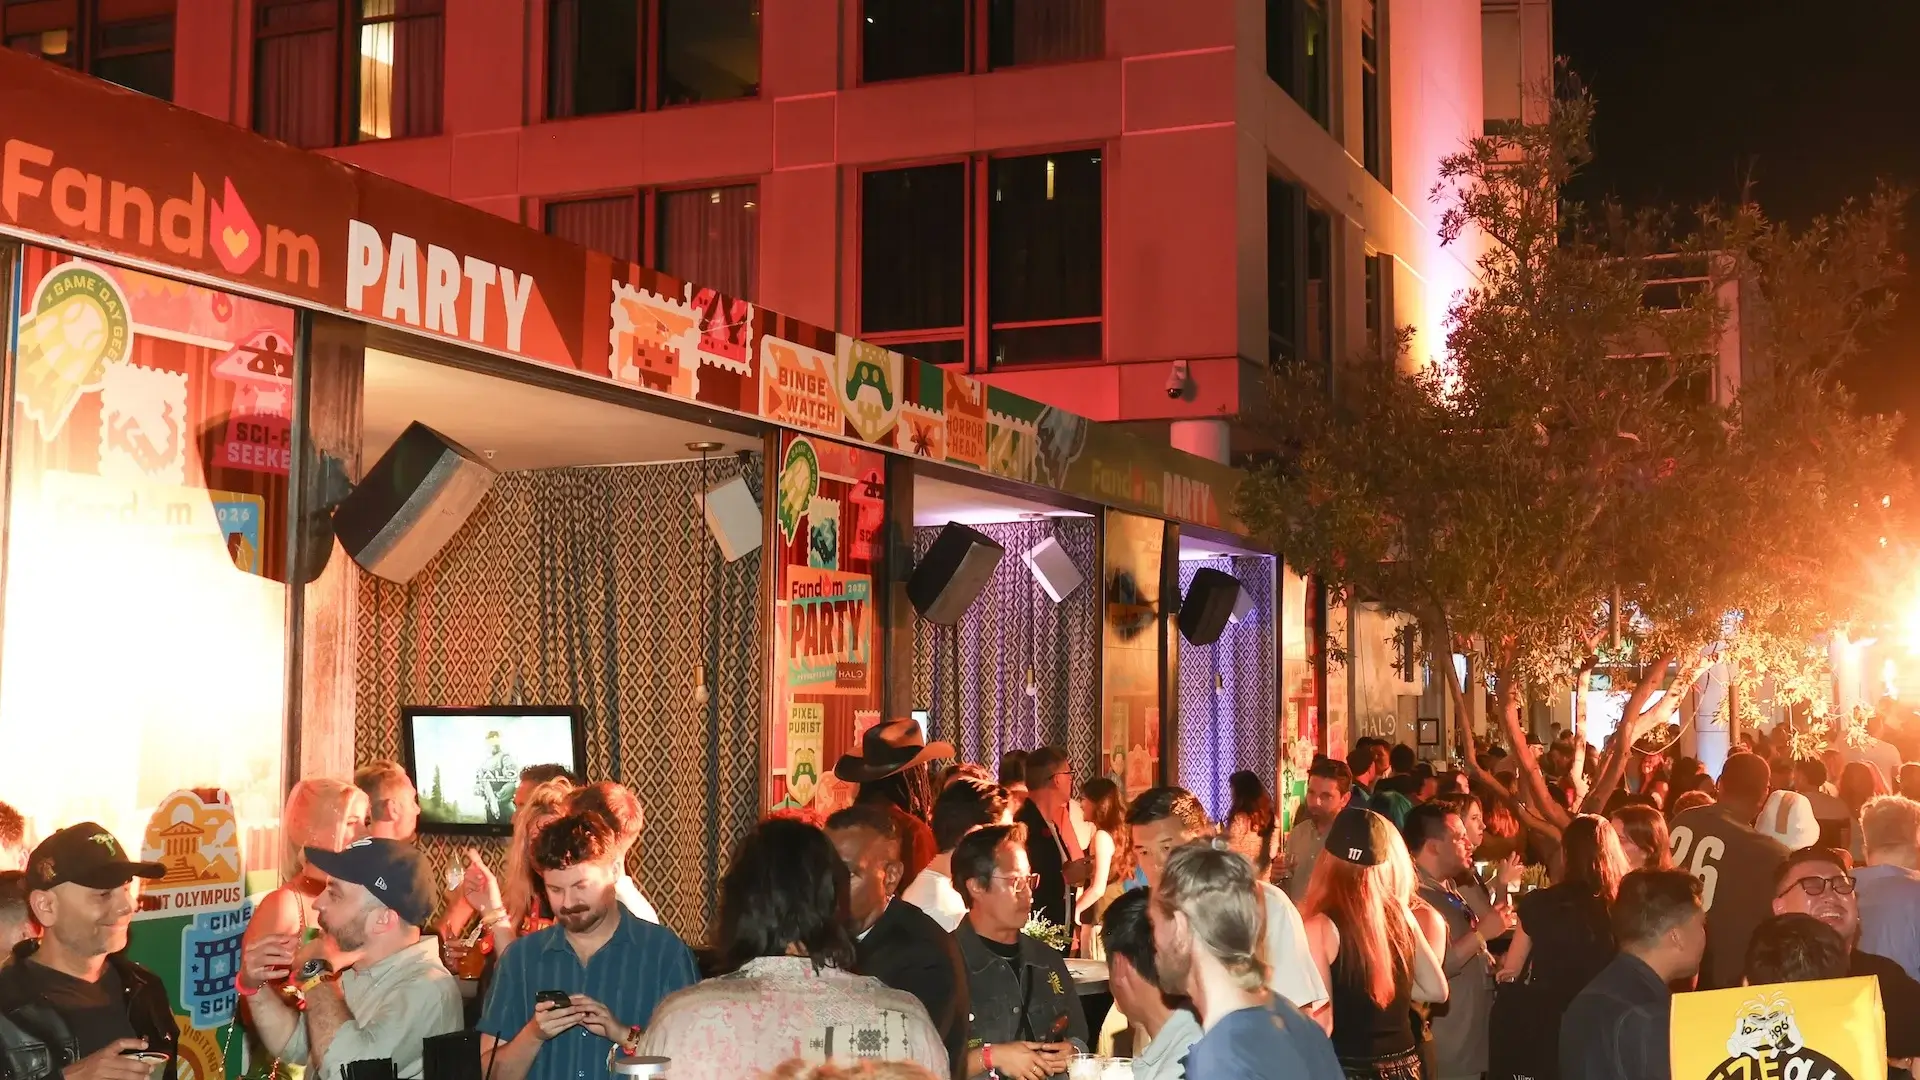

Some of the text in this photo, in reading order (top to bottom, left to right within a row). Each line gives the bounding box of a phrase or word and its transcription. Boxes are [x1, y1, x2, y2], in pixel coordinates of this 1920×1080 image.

[346, 218, 534, 352] PARTY
[54, 275, 123, 361] GAME DAY GEE
[778, 366, 826, 397] BINGE
[786, 393, 836, 423] WATCH
[236, 421, 290, 449] SCI-F
[946, 414, 983, 445] HORROR
[227, 441, 290, 469] SEEKE
[952, 435, 977, 458] HEAD
[1163, 470, 1210, 525] PARTY
[217, 507, 250, 523] 026
[790, 598, 863, 659] PARTY
[838, 670, 864, 678] HALO
[792, 707, 818, 720] PIXEL
[1360, 714, 1396, 737] HALO
[788, 721, 821, 734] PURIST
[1347, 847, 1363, 860] 117
[174, 886, 241, 909] OLYMPUS
[210, 910, 251, 931] CINE
[200, 993, 237, 1015] SCH
[183, 1023, 219, 1073] VISITING
